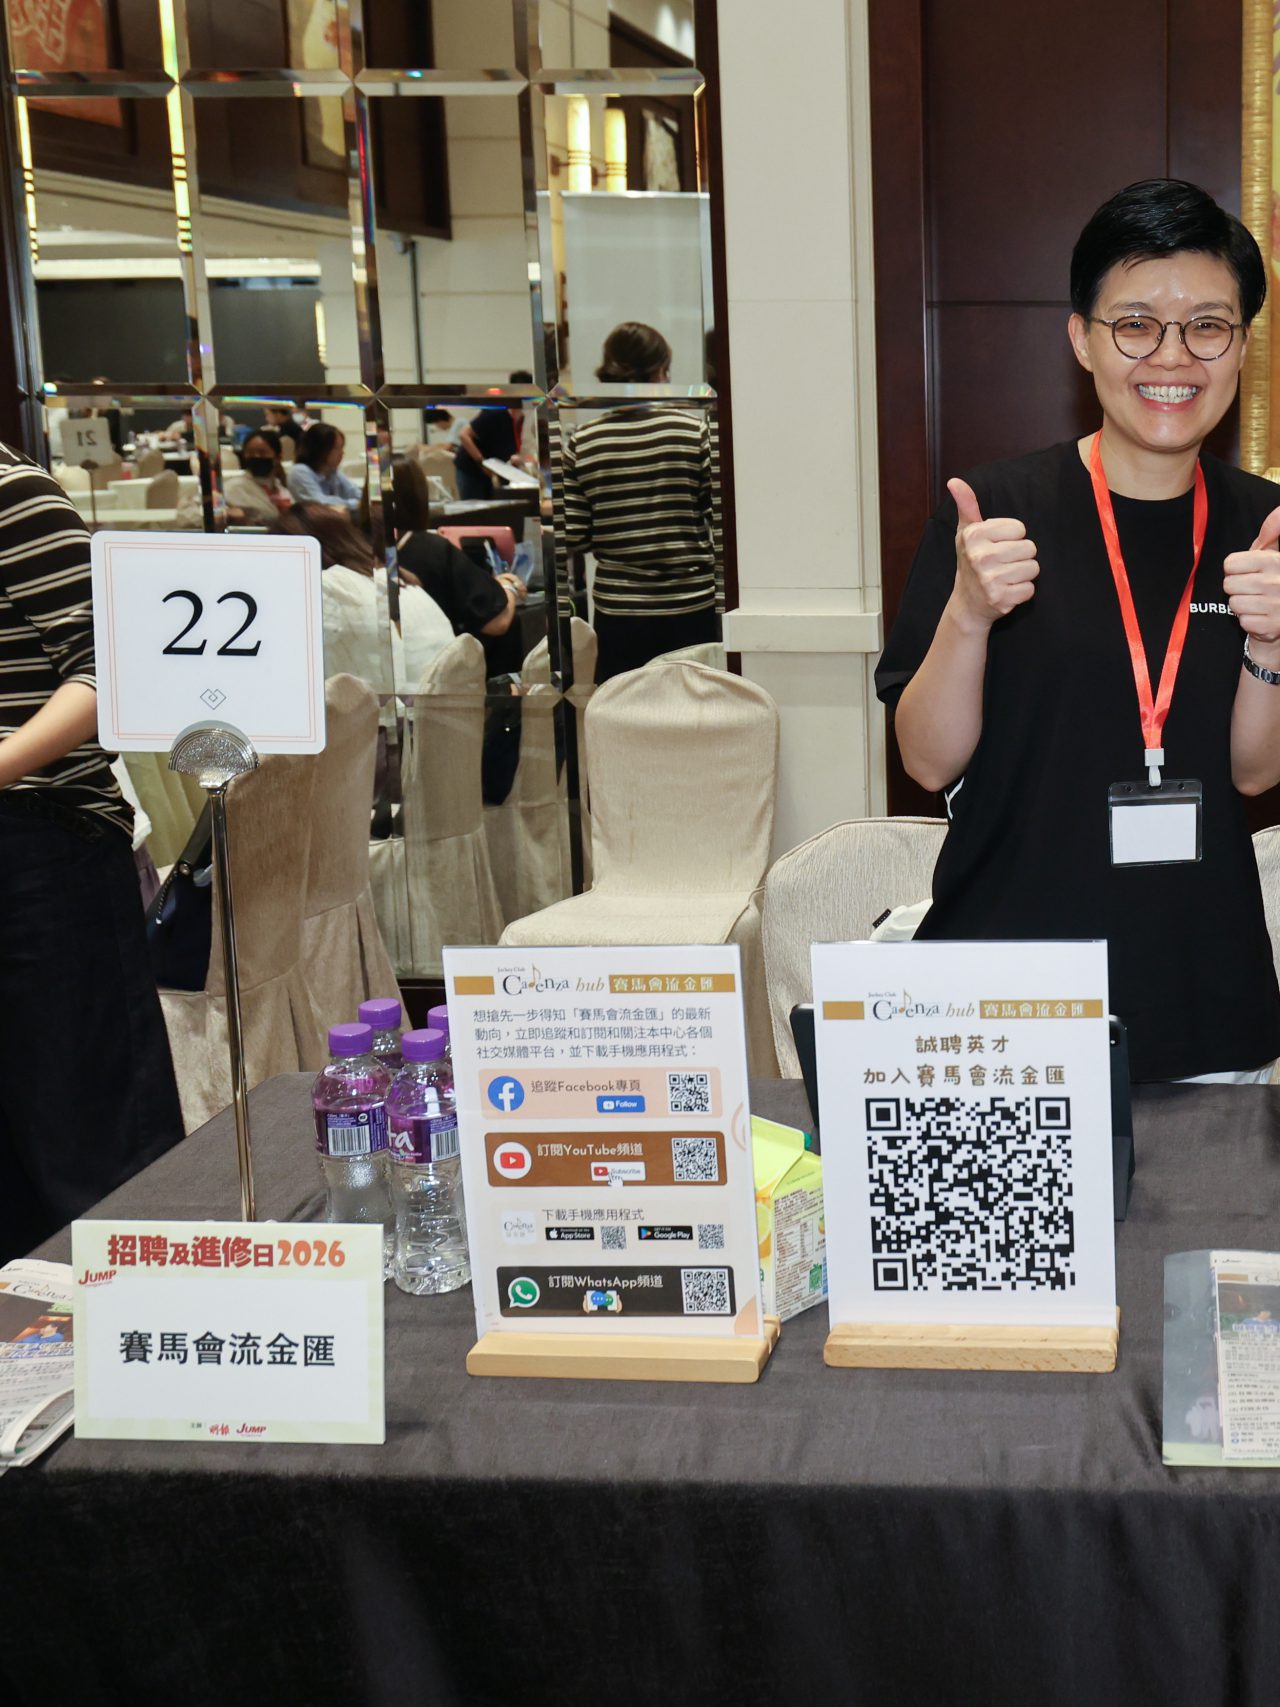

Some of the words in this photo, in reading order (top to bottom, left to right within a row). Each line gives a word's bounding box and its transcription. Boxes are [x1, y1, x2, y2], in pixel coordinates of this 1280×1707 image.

[1190, 602, 1239, 617] BURBE
[162, 589, 262, 657] 22
[575, 977, 605, 992] hub
[614, 976, 714, 992] 賽馬會流金匯
[946, 1002, 975, 1017] hub
[984, 1001, 1085, 1017] 賽馬會流金匯
[915, 1034, 1009, 1055] 誠聘英才
[863, 1063, 1066, 1088] 加入賽馬會流金匯
[531, 1079, 641, 1093] 追蹤Facebook專頁
[616, 1100, 638, 1108] Follow
[542, 1208, 645, 1221] 下載手機應用程式
[561, 1232, 574, 1240] App
[654, 1231, 677, 1240] Google
[677, 1231, 690, 1239] Play
[107, 1234, 346, 1267] 招聘及進修日2026
[79, 1269, 117, 1285] JUMP
[119, 1330, 336, 1367] 賽馬會流金匯
[236, 1422, 267, 1434] JUMP
